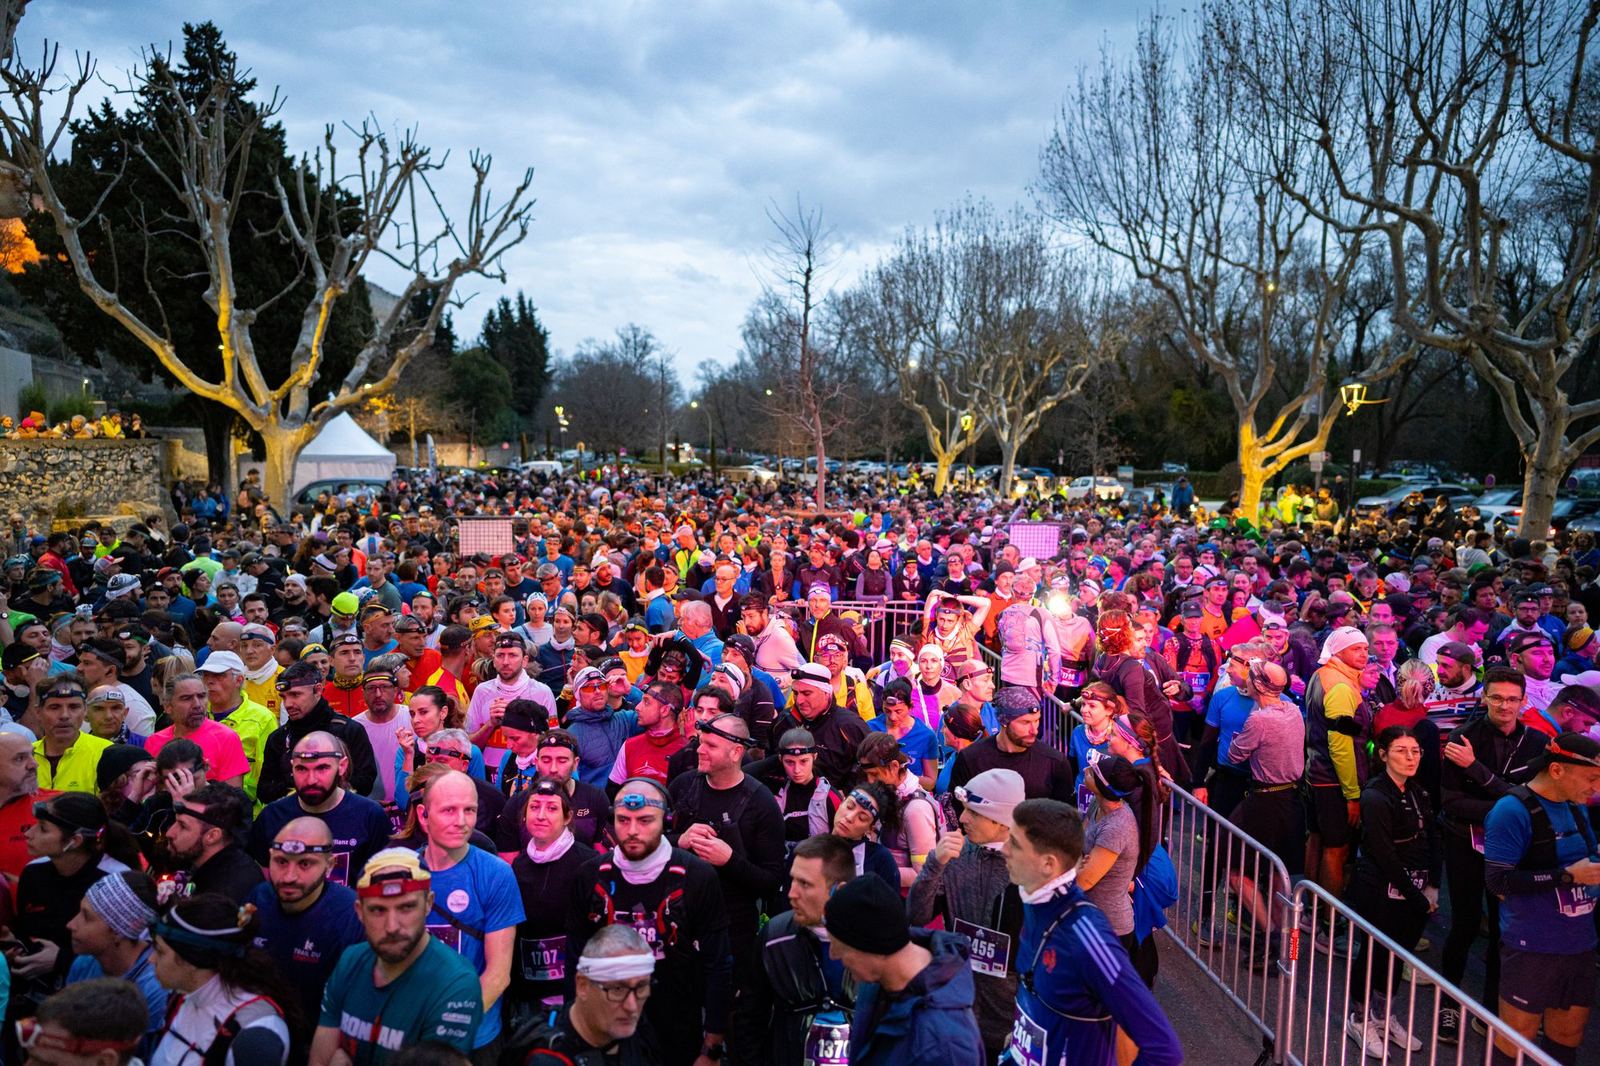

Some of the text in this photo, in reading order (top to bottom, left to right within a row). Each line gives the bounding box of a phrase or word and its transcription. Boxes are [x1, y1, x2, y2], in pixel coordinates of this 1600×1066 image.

[332, 838, 349, 846] llianz
[966, 936, 996, 959] 455
[531, 949, 558, 966] 1707
